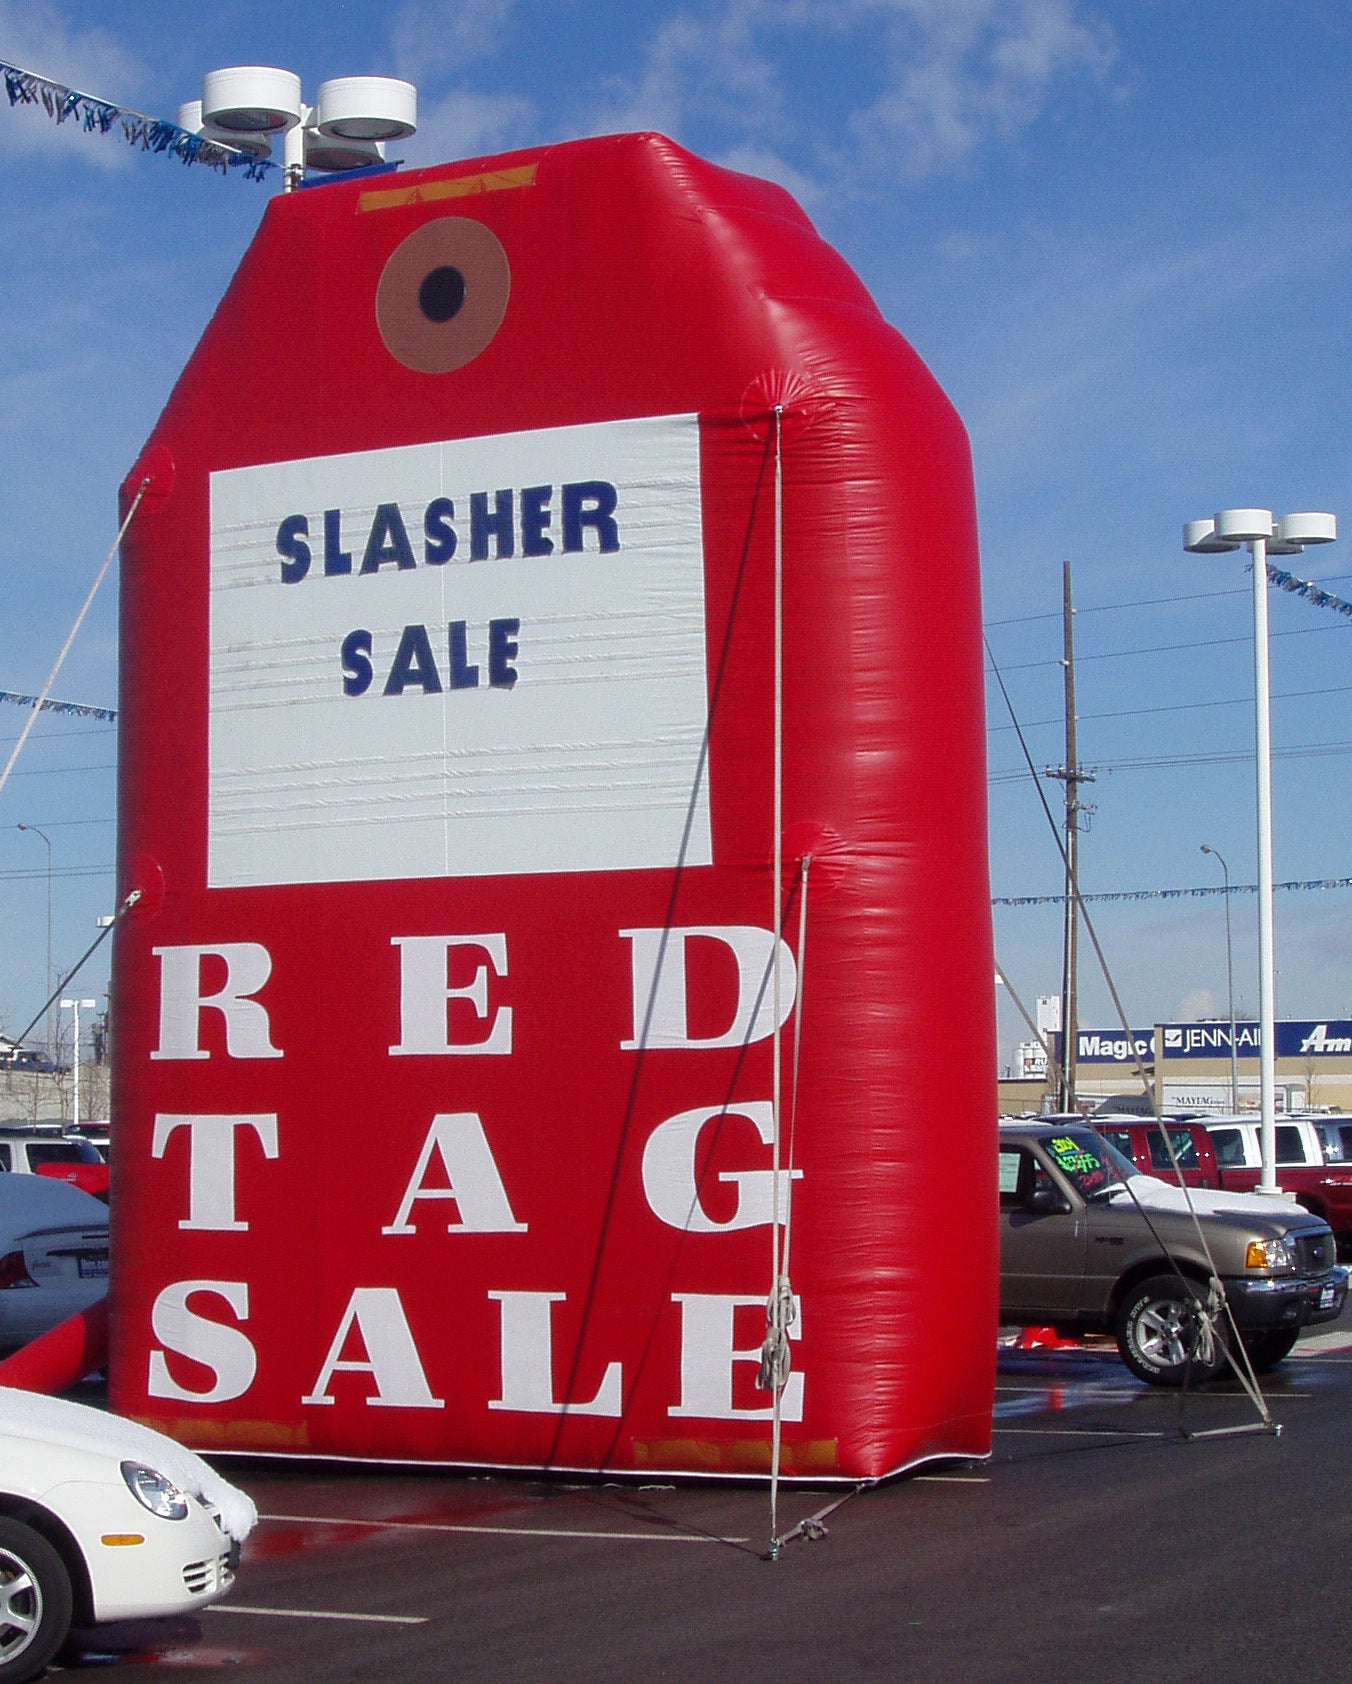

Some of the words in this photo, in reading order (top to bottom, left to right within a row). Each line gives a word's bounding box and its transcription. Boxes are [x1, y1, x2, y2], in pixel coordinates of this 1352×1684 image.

[276, 480, 620, 584] SLASHER
[341, 618, 521, 697] SALE
[150, 925, 798, 1060] RED
[151, 1100, 805, 1234] TAG
[148, 1279, 806, 1423] SALE
